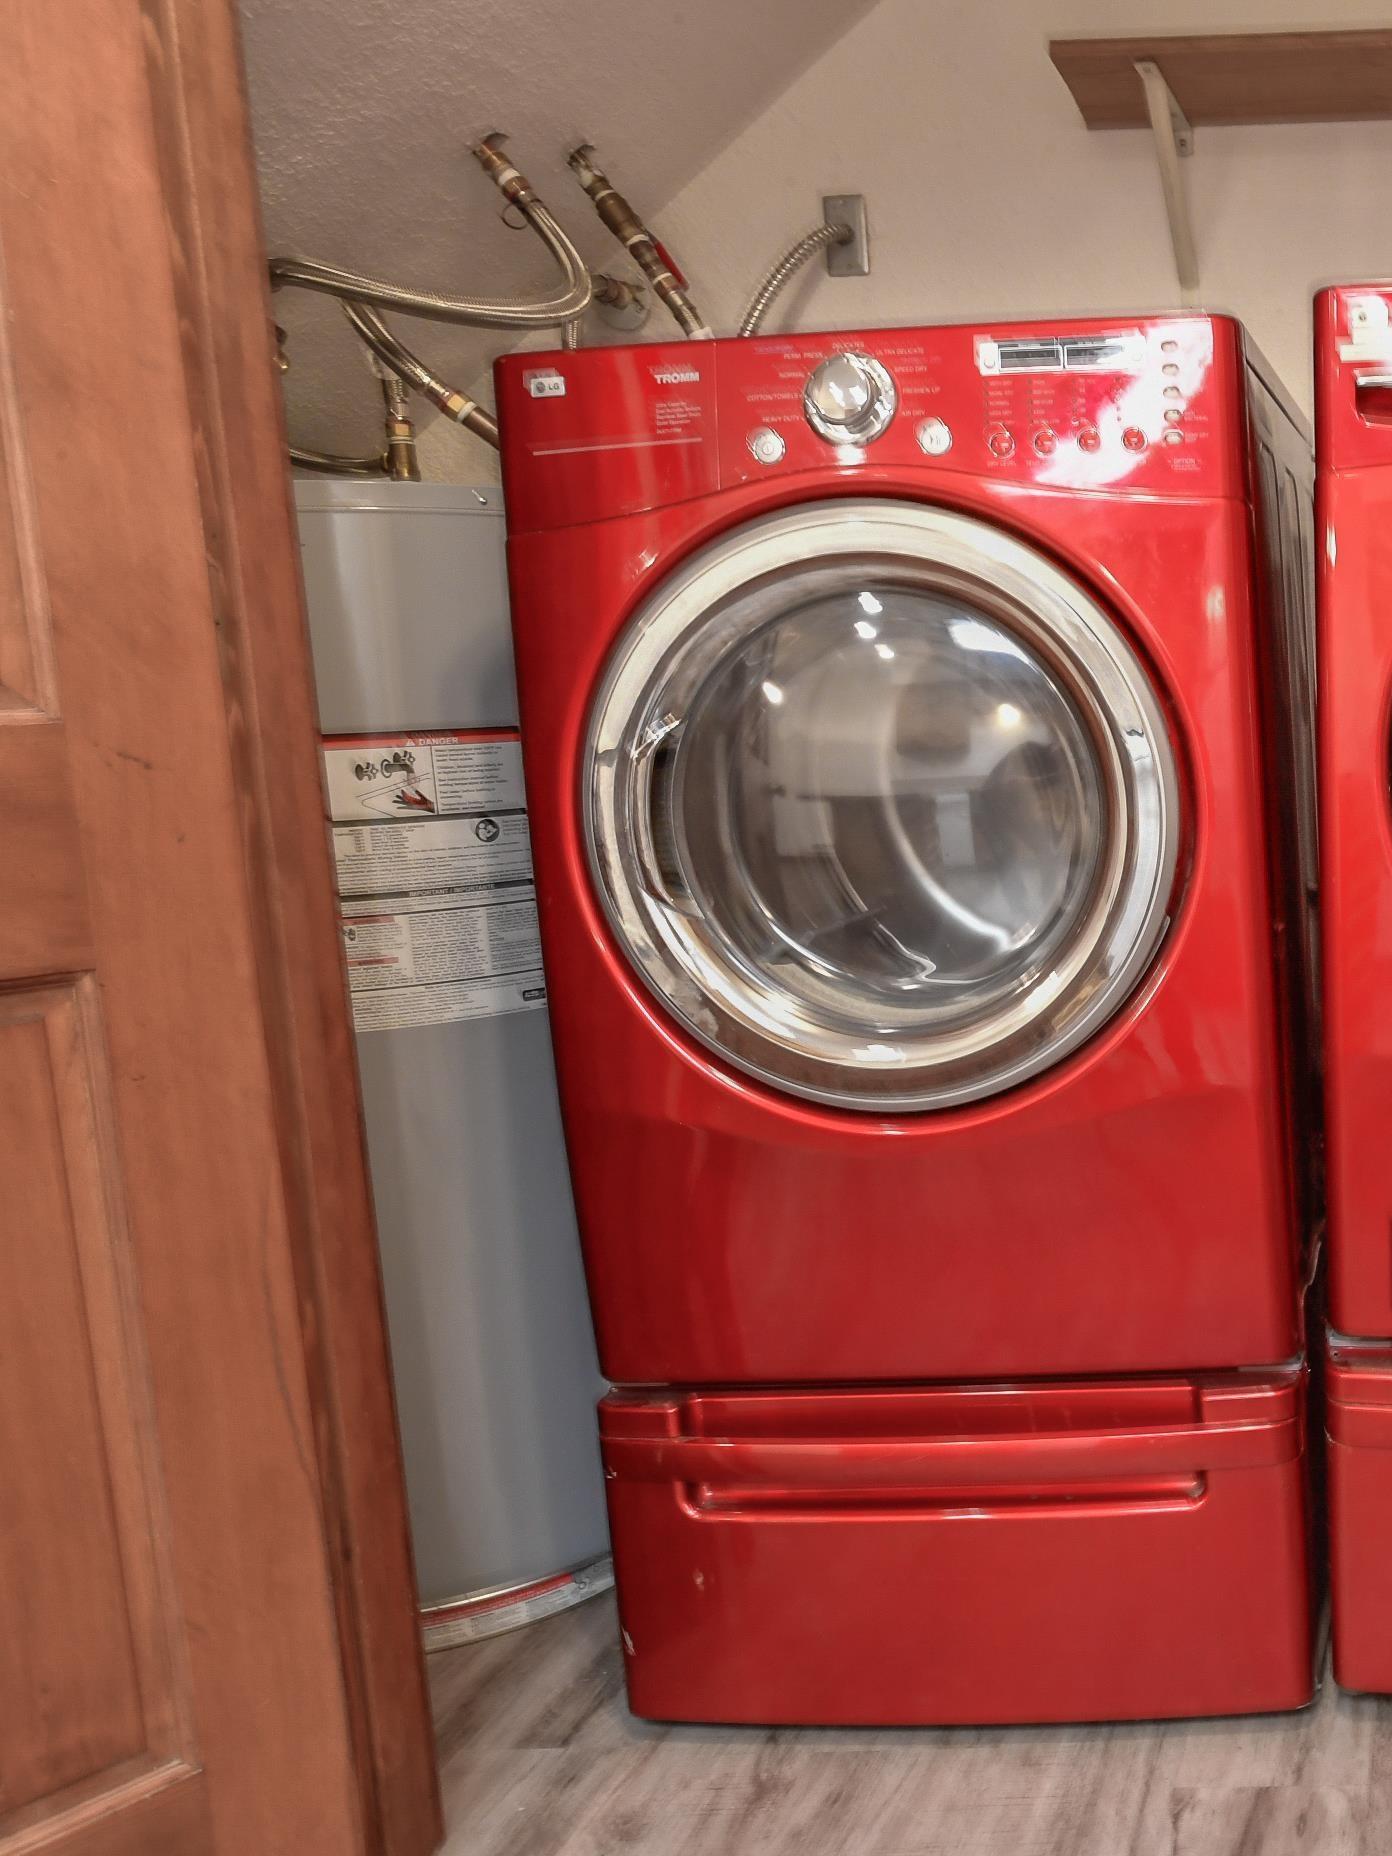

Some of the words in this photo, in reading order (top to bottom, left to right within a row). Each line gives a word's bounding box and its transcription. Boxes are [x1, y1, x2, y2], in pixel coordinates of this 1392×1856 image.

[654, 371, 699, 384] TROMM
[549, 383, 560, 391] LG
[418, 736, 459, 746] DANGER
